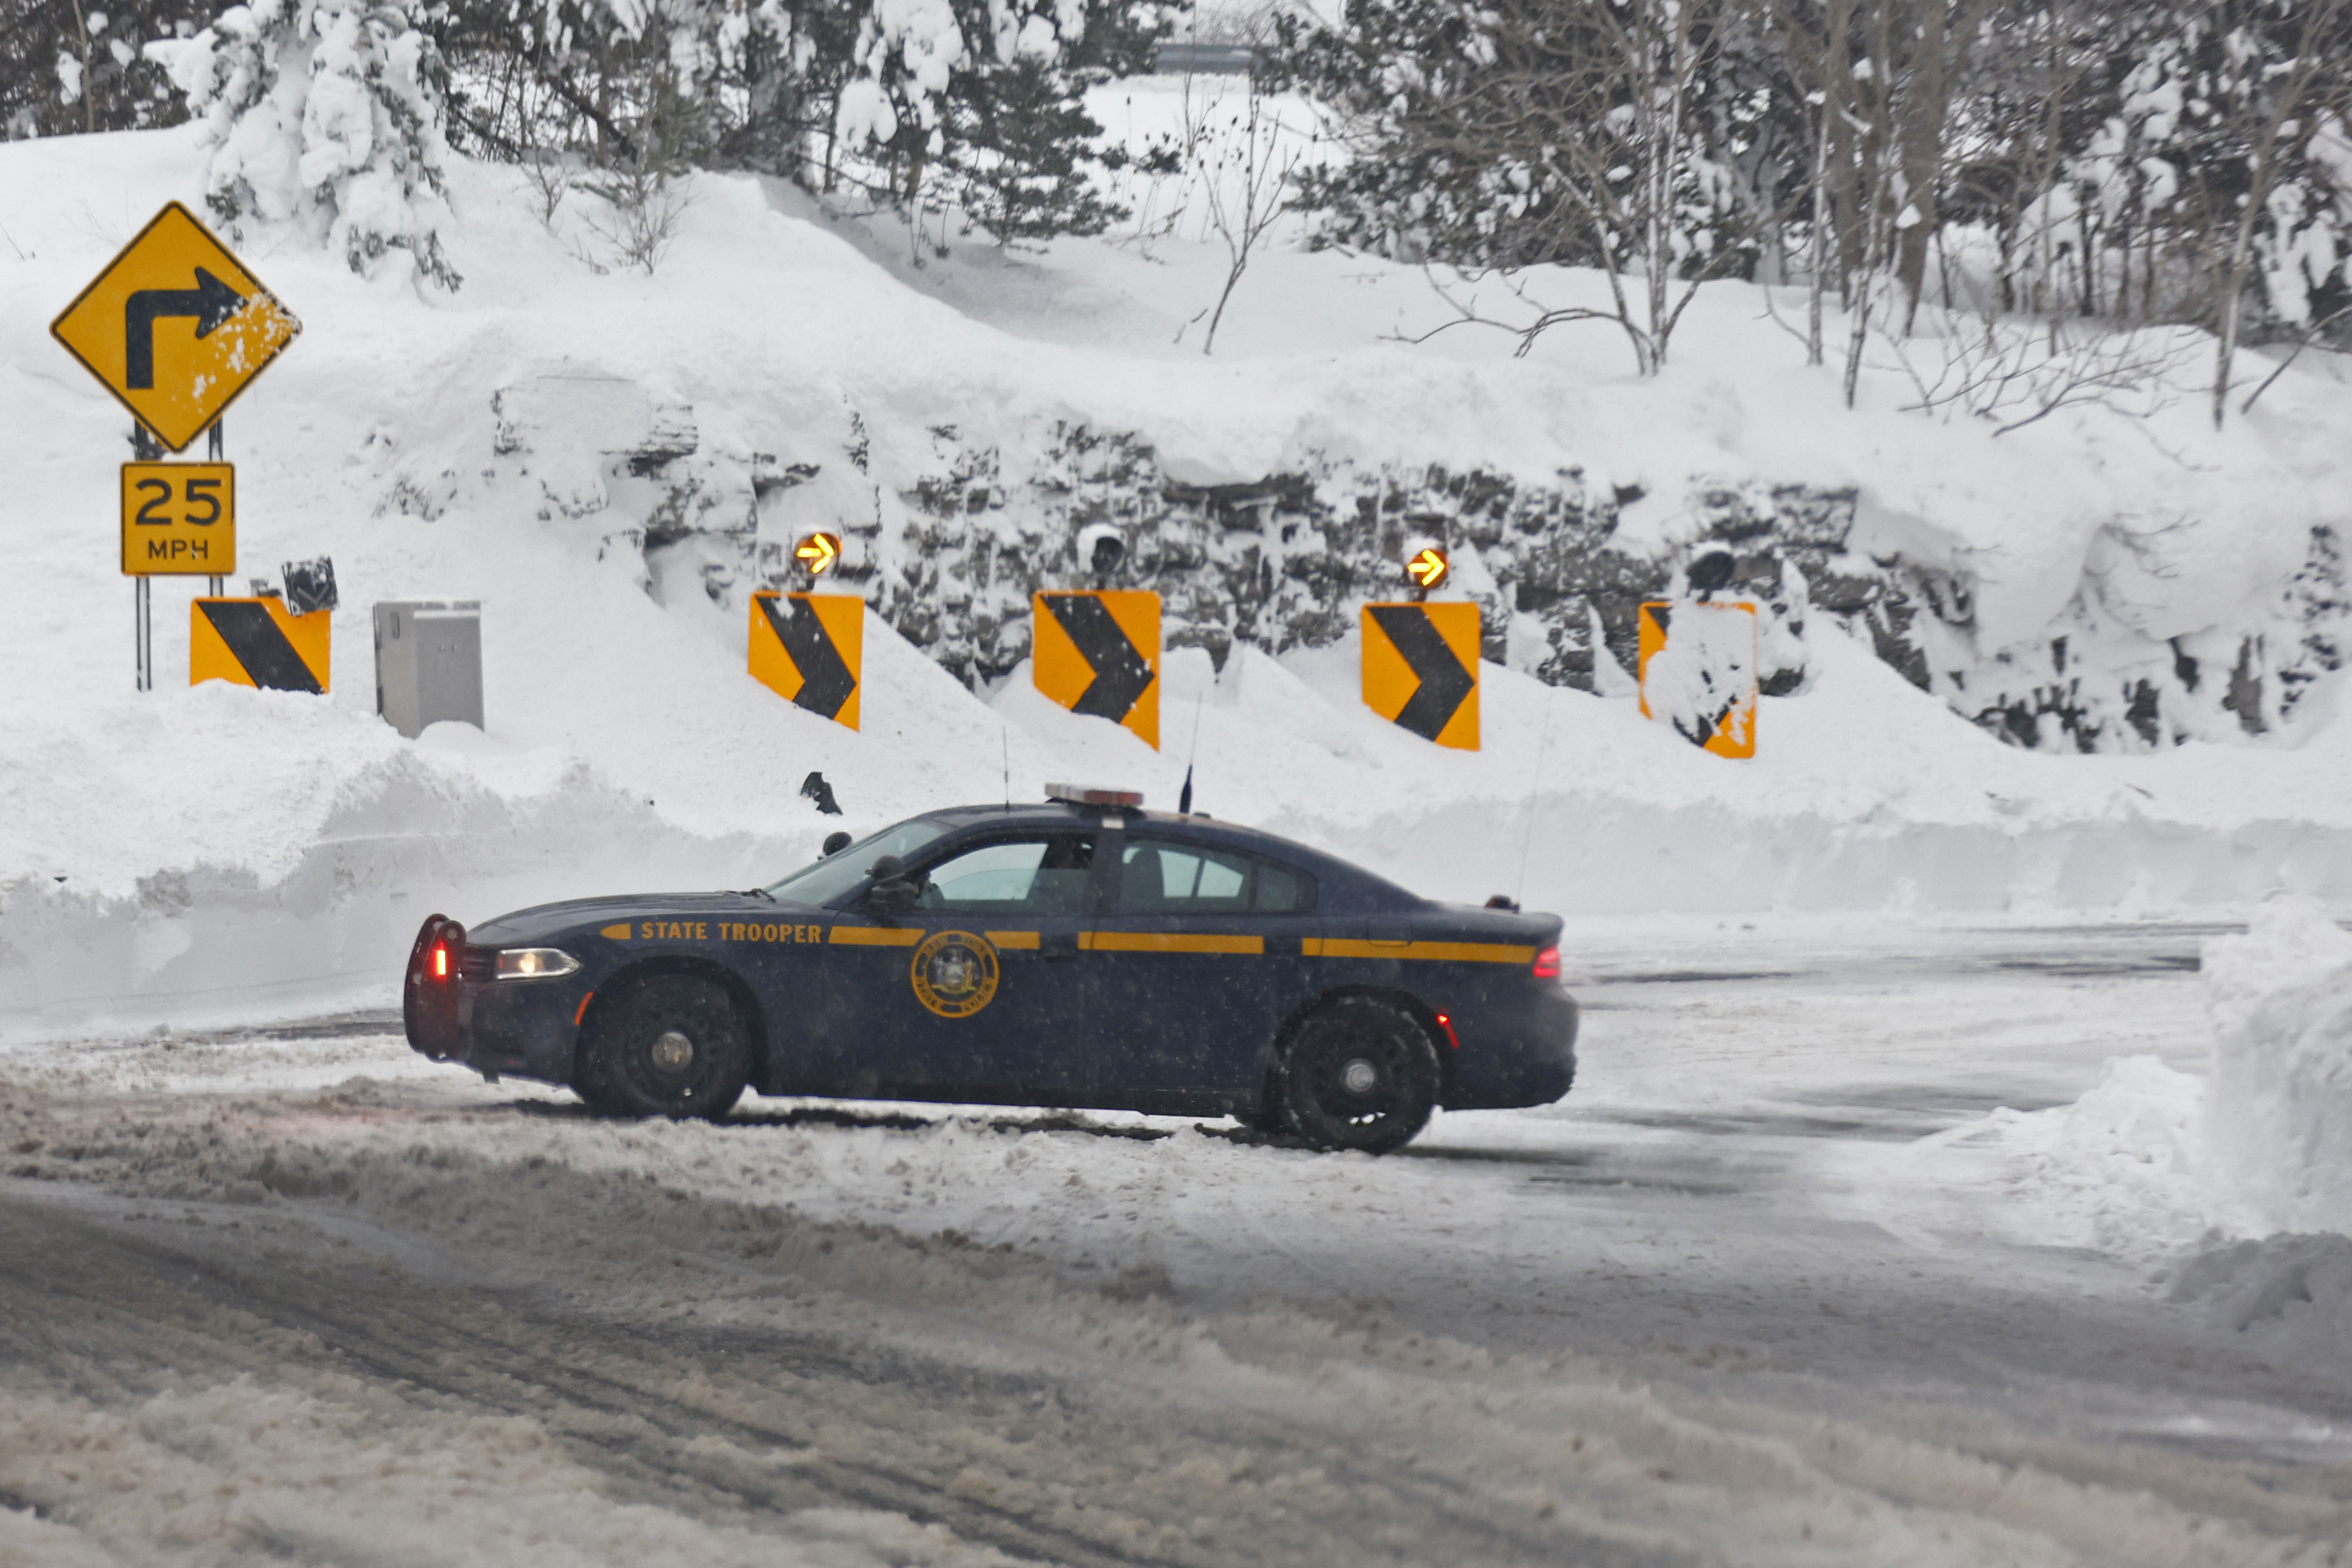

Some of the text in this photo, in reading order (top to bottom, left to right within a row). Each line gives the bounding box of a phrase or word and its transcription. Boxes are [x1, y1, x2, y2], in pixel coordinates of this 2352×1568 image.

[136, 478, 221, 526] 25
[148, 539, 208, 560] MPH
[642, 922, 822, 943] STATE TROOPER
